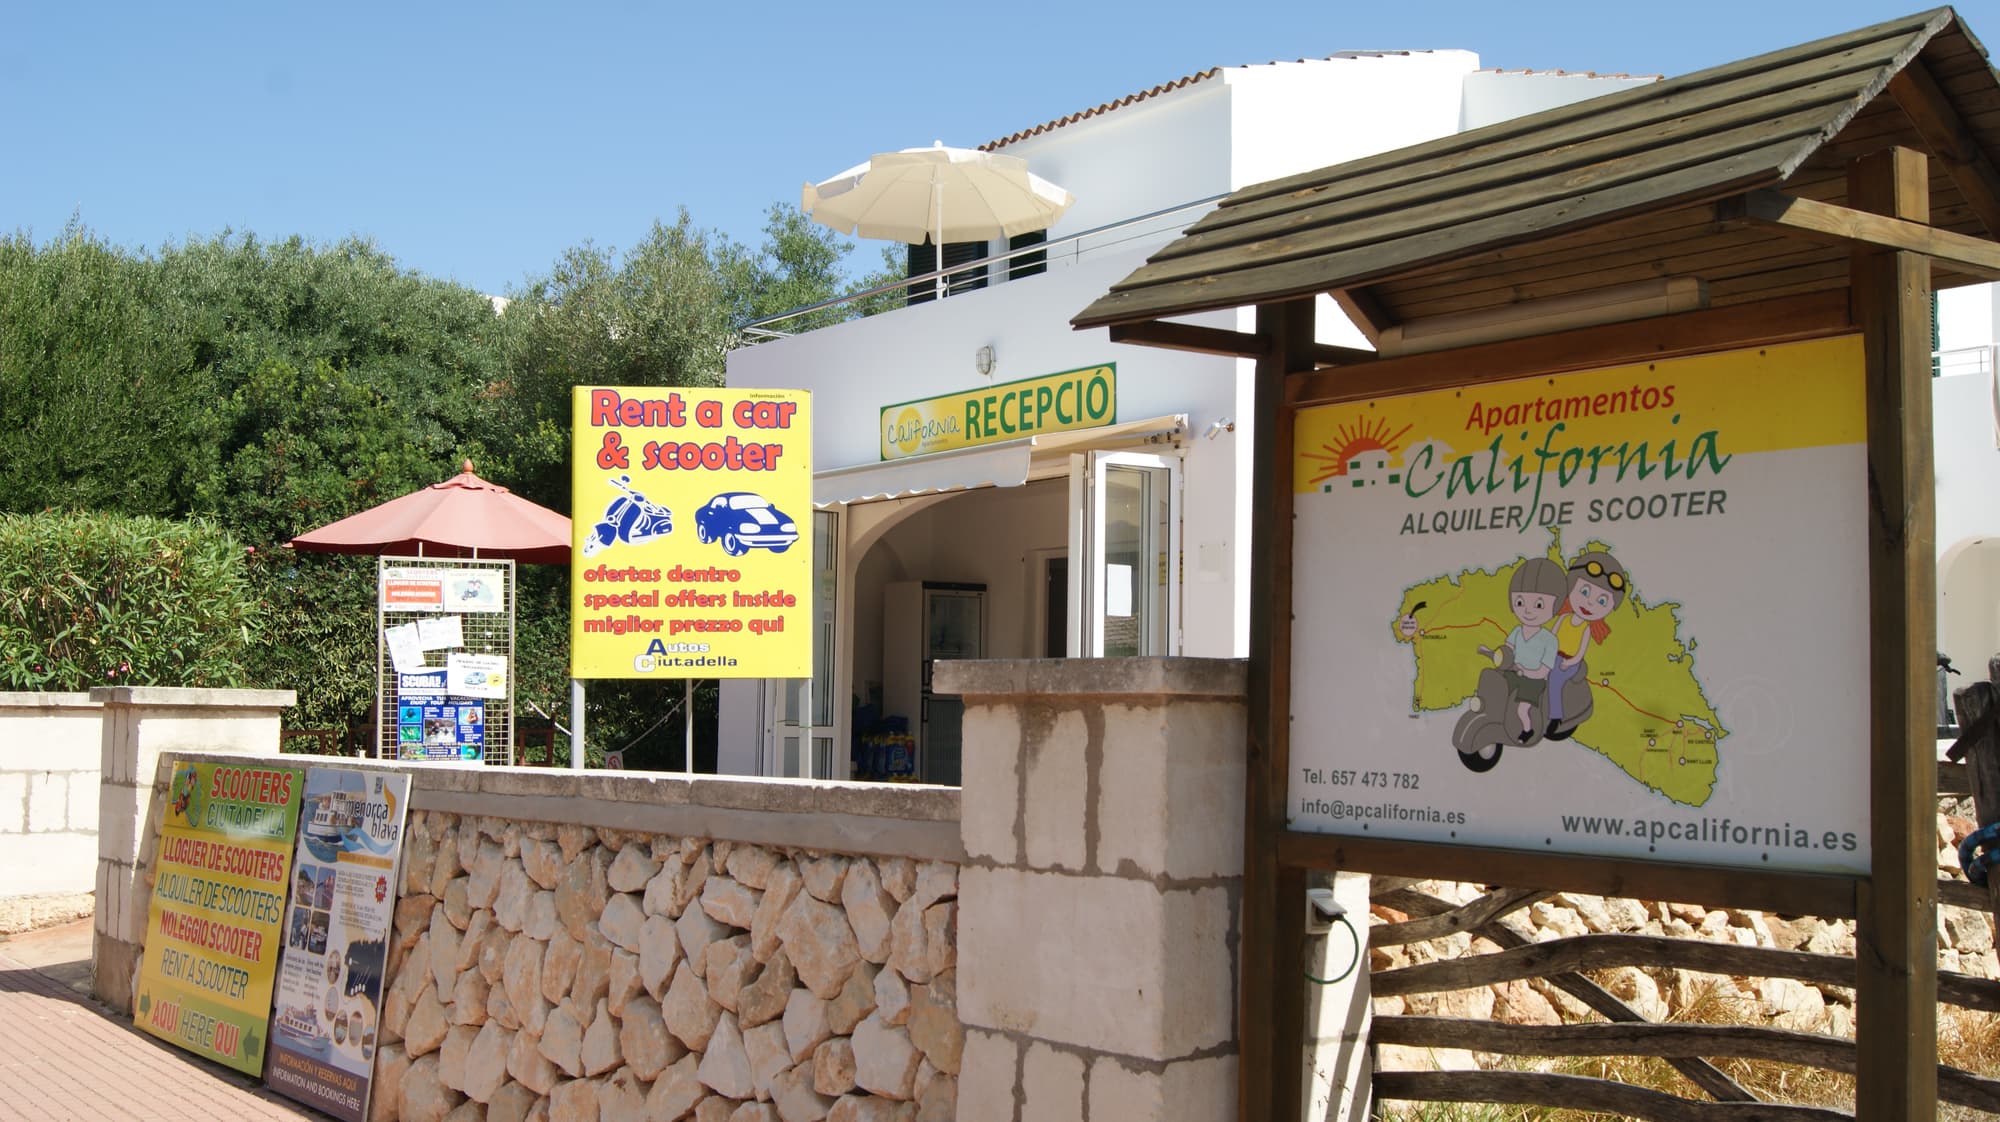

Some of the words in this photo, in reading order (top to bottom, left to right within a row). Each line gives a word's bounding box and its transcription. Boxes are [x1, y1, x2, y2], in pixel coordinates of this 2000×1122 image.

[590, 388, 686, 428] Rent
[695, 400, 723, 428] a
[733, 399, 797, 429] car
[965, 369, 1109, 440] RECEPCIÓ
[1465, 384, 1675, 436] Apartamentos
[596, 431, 629, 470] &
[642, 435, 783, 472] scooter
[1404, 413, 1732, 534] California
[1399, 504, 1524, 535] ALQUILER
[1538, 501, 1575, 526] DE
[1587, 489, 1727, 523] SCOOTER
[583, 563, 662, 583] ofertas
[667, 564, 741, 583] dentro
[583, 589, 659, 610] special
[664, 589, 727, 608] offers
[733, 590, 797, 608] inside
[583, 615, 664, 635] miglior
[669, 616, 742, 635] prezzo
[748, 615, 784, 635] qui
[634, 654, 738, 673] Ciutadella
[646, 638, 710, 656] Autos
[211, 767, 293, 806] SCOOTERS
[1302, 768, 1327, 784] Tel.
[1331, 770, 1357, 786] 657
[1361, 772, 1388, 788] 473
[1393, 773, 1420, 789] 782
[207, 803, 285, 837] CIUTADELLA
[346, 799, 389, 821] menorca
[371, 813, 399, 841] blava
[1302, 798, 1466, 825] info@apcalifornia.es
[1562, 815, 1857, 851] www.apcalifornia.es
[162, 835, 207, 868] LLOGUER
[207, 845, 222, 872] DE
[222, 848, 285, 883] SCOOTERS
[155, 871, 203, 907] ALQUILER
[203, 881, 218, 910] DE
[221, 883, 282, 925] SCOOTERS
[160, 910, 207, 947] NOLEGGIO
[208, 921, 263, 963] SCOOTER
[160, 948, 187, 979] RENT
[186, 957, 197, 982] A
[197, 958, 249, 1000] SCOOTER
[151, 996, 180, 1034] AQUÍ
[179, 1008, 216, 1049] HERE
[214, 1021, 241, 1058] QUI
[272, 1066, 306, 1089] INFORMATION
[306, 1079, 318, 1094] AND
[318, 1084, 346, 1105] BOOKINGS
[346, 1095, 361, 1112] HERE
